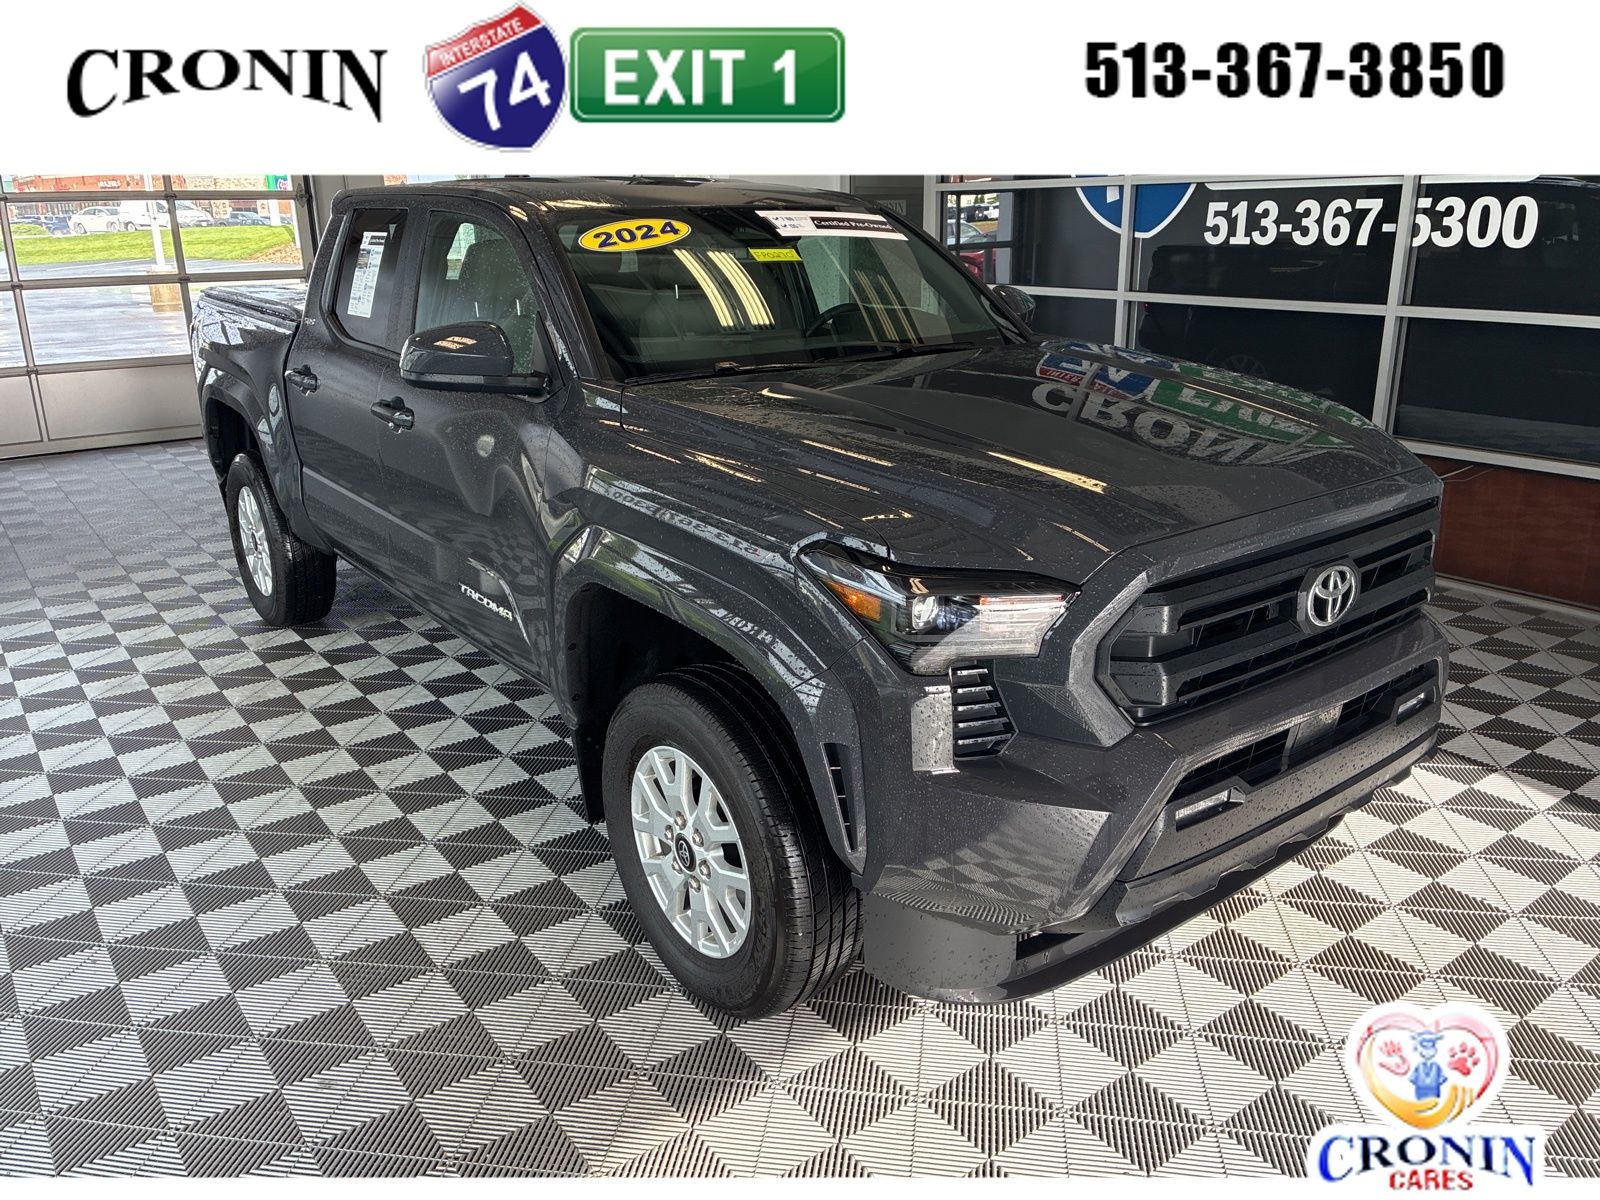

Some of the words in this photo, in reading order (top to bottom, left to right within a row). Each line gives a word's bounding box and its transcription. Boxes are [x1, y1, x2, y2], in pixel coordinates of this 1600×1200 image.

[592, 220, 681, 249] 2024
[813, 219, 850, 227] Certified
[1204, 195, 1538, 249] 513-367-5300
[458, 582, 513, 621] TACOMA
